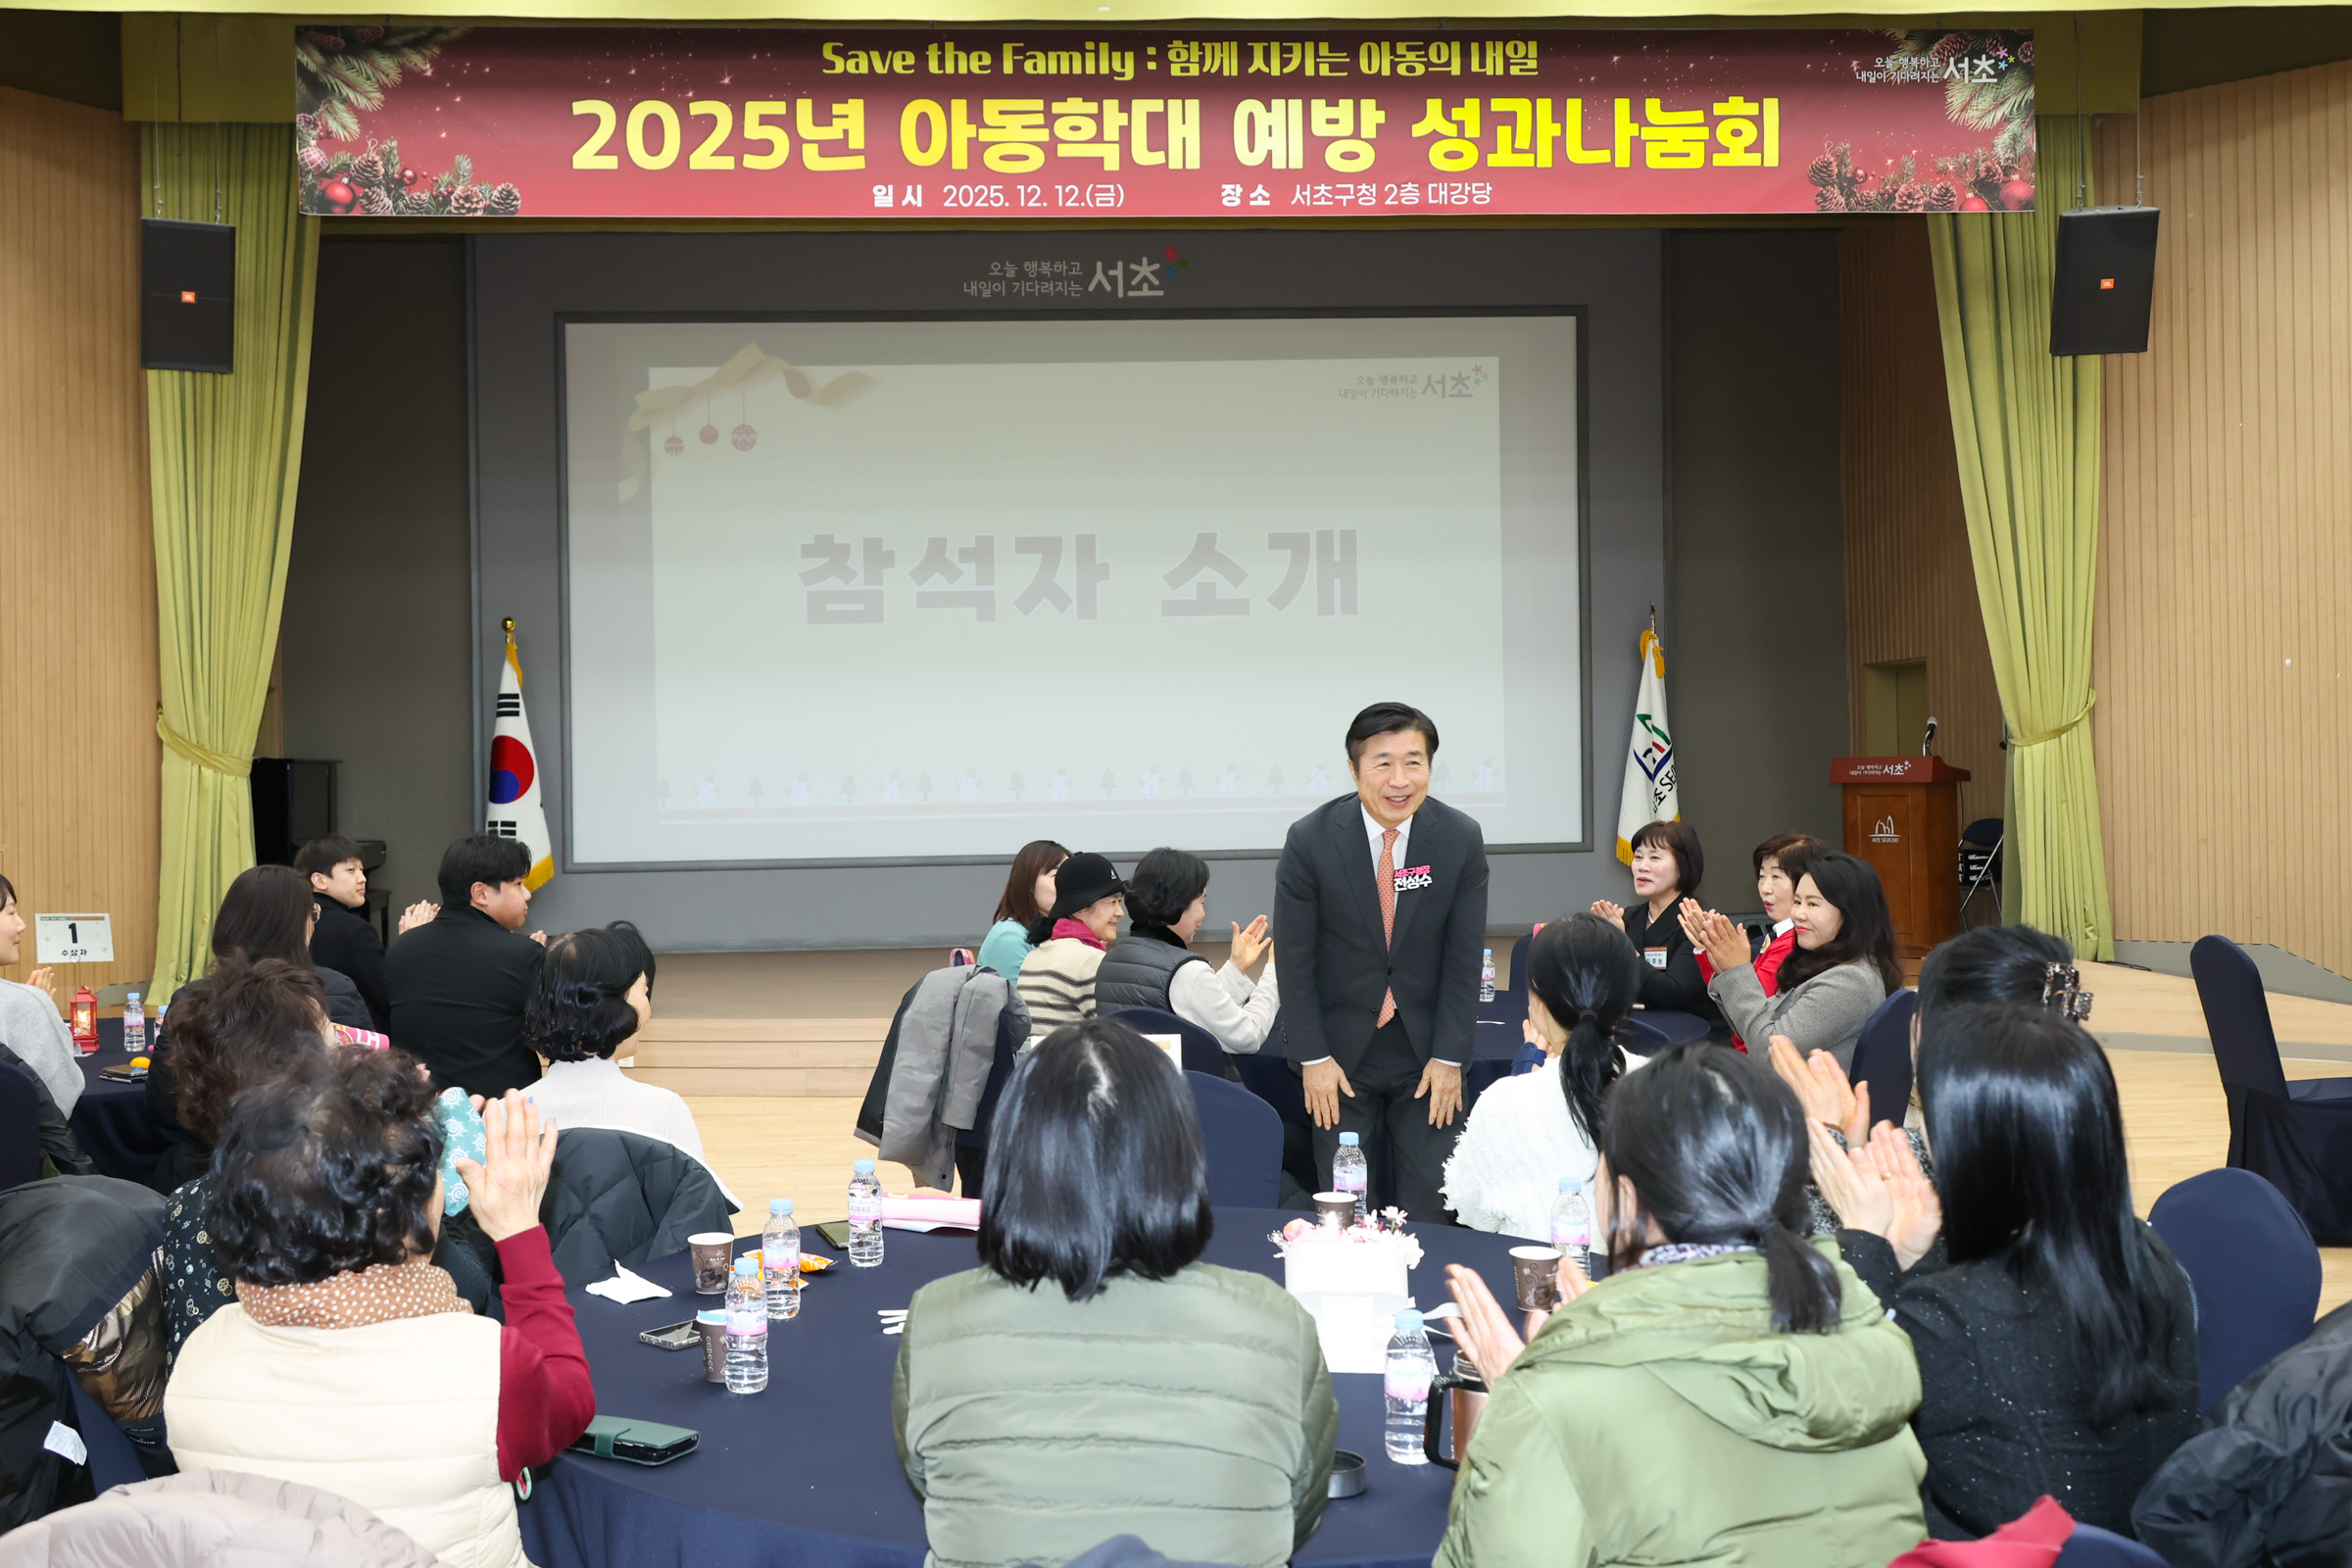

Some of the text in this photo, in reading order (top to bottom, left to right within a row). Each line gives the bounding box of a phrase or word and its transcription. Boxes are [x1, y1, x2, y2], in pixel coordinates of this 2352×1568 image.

[822, 41, 916, 74] Save
[925, 41, 992, 74] the
[1003, 41, 1135, 81] Family
[1167, 40, 1238, 76] 함께
[1247, 40, 1350, 76] 지키는
[1359, 40, 1461, 76] 아동의
[1470, 39, 1540, 76] 내일
[1874, 56, 1941, 70] 오늘 행복하고
[1943, 54, 1998, 84] 서초
[1856, 71, 1941, 83] 내일이 기다려지는
[570, 95, 1780, 174] 2025년 아동학대 예방 성과나눔회
[943, 184, 1009, 208] 2025.
[1291, 182, 1377, 207] 서초구청
[1384, 181, 1421, 206] 2층
[1428, 181, 1493, 206] 대강당
[989, 260, 1083, 278] 오늘 행복하고
[1088, 256, 1164, 299] 서초
[963, 279, 1084, 297] 내일이 기다려지는
[1356, 373, 1419, 386] 오늘 행복하고
[1422, 370, 1473, 399] 서초
[1339, 387, 1419, 400] 내일이 기다려지는
[798, 528, 1359, 625] 참석자 소개
[1883, 763, 1905, 775] 서초
[1393, 873, 1433, 892] 전성수
[68, 922, 78, 944] 1
